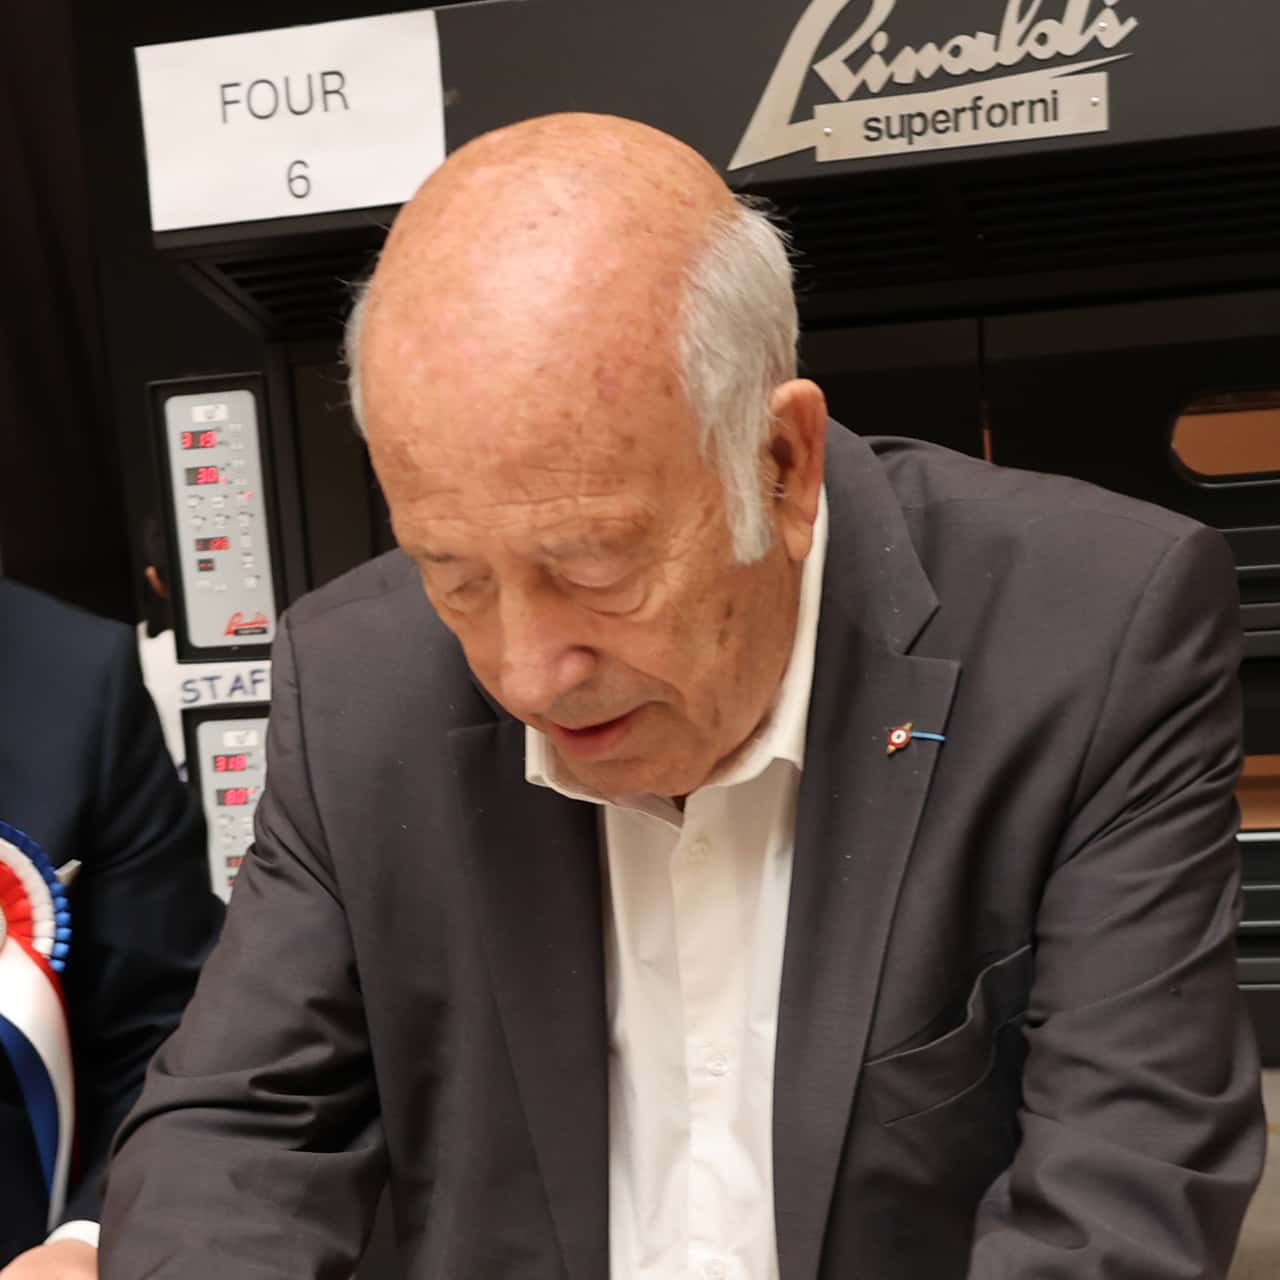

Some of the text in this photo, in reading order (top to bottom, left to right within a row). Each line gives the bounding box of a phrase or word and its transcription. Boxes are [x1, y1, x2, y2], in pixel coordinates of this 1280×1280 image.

[217, 69, 351, 125] FOUR
[727, 0, 1139, 171] Rinaldi
[863, 90, 1059, 145] superforni
[285, 159, 312, 199] 6
